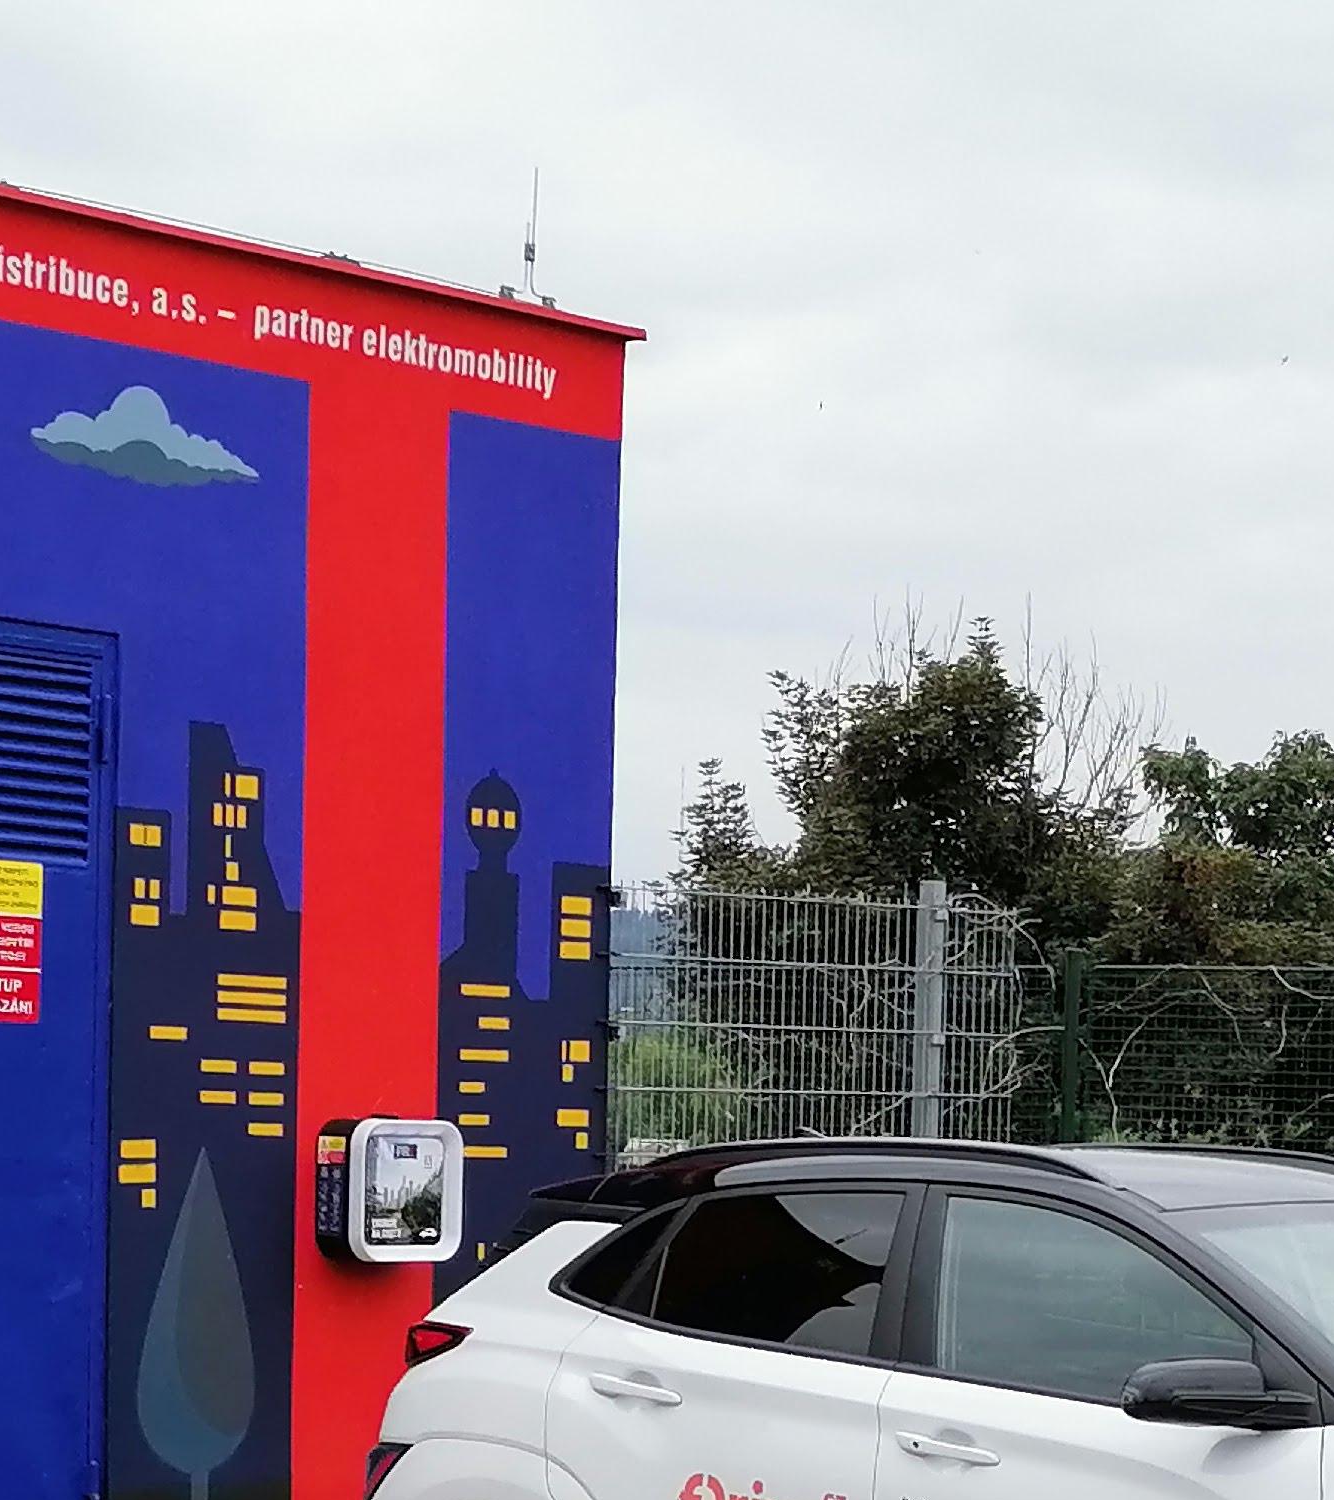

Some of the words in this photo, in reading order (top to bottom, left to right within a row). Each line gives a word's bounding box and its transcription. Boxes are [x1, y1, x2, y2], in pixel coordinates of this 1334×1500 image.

[152, 286, 207, 325] a.s.
[254, 304, 354, 351] partner
[362, 324, 557, 400] elektromobility
